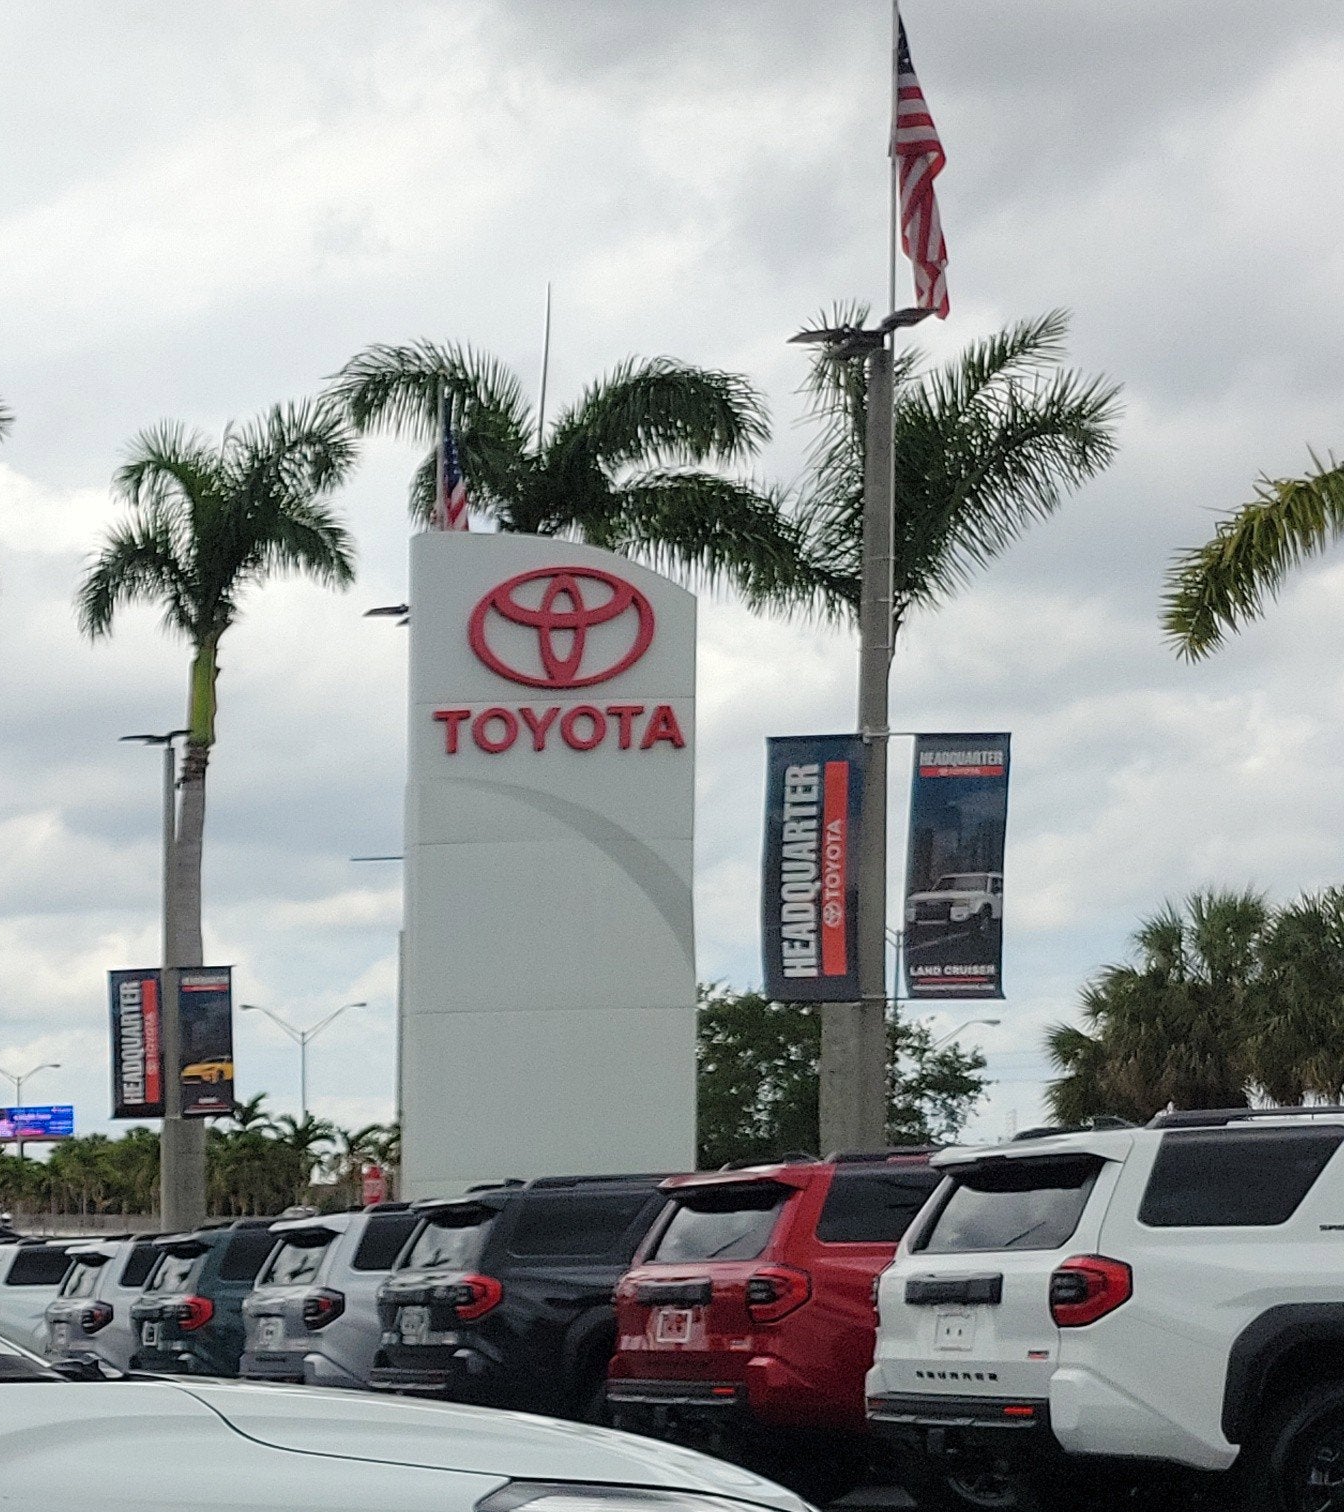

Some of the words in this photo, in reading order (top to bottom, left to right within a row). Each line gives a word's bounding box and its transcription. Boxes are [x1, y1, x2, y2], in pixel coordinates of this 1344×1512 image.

[432, 705, 686, 755] TOYOTA
[780, 763, 821, 978] HEADQUARTER
[825, 818, 843, 901] TOYOTA
[909, 965, 942, 976] LAND
[119, 980, 146, 1105] HEADQUARTER
